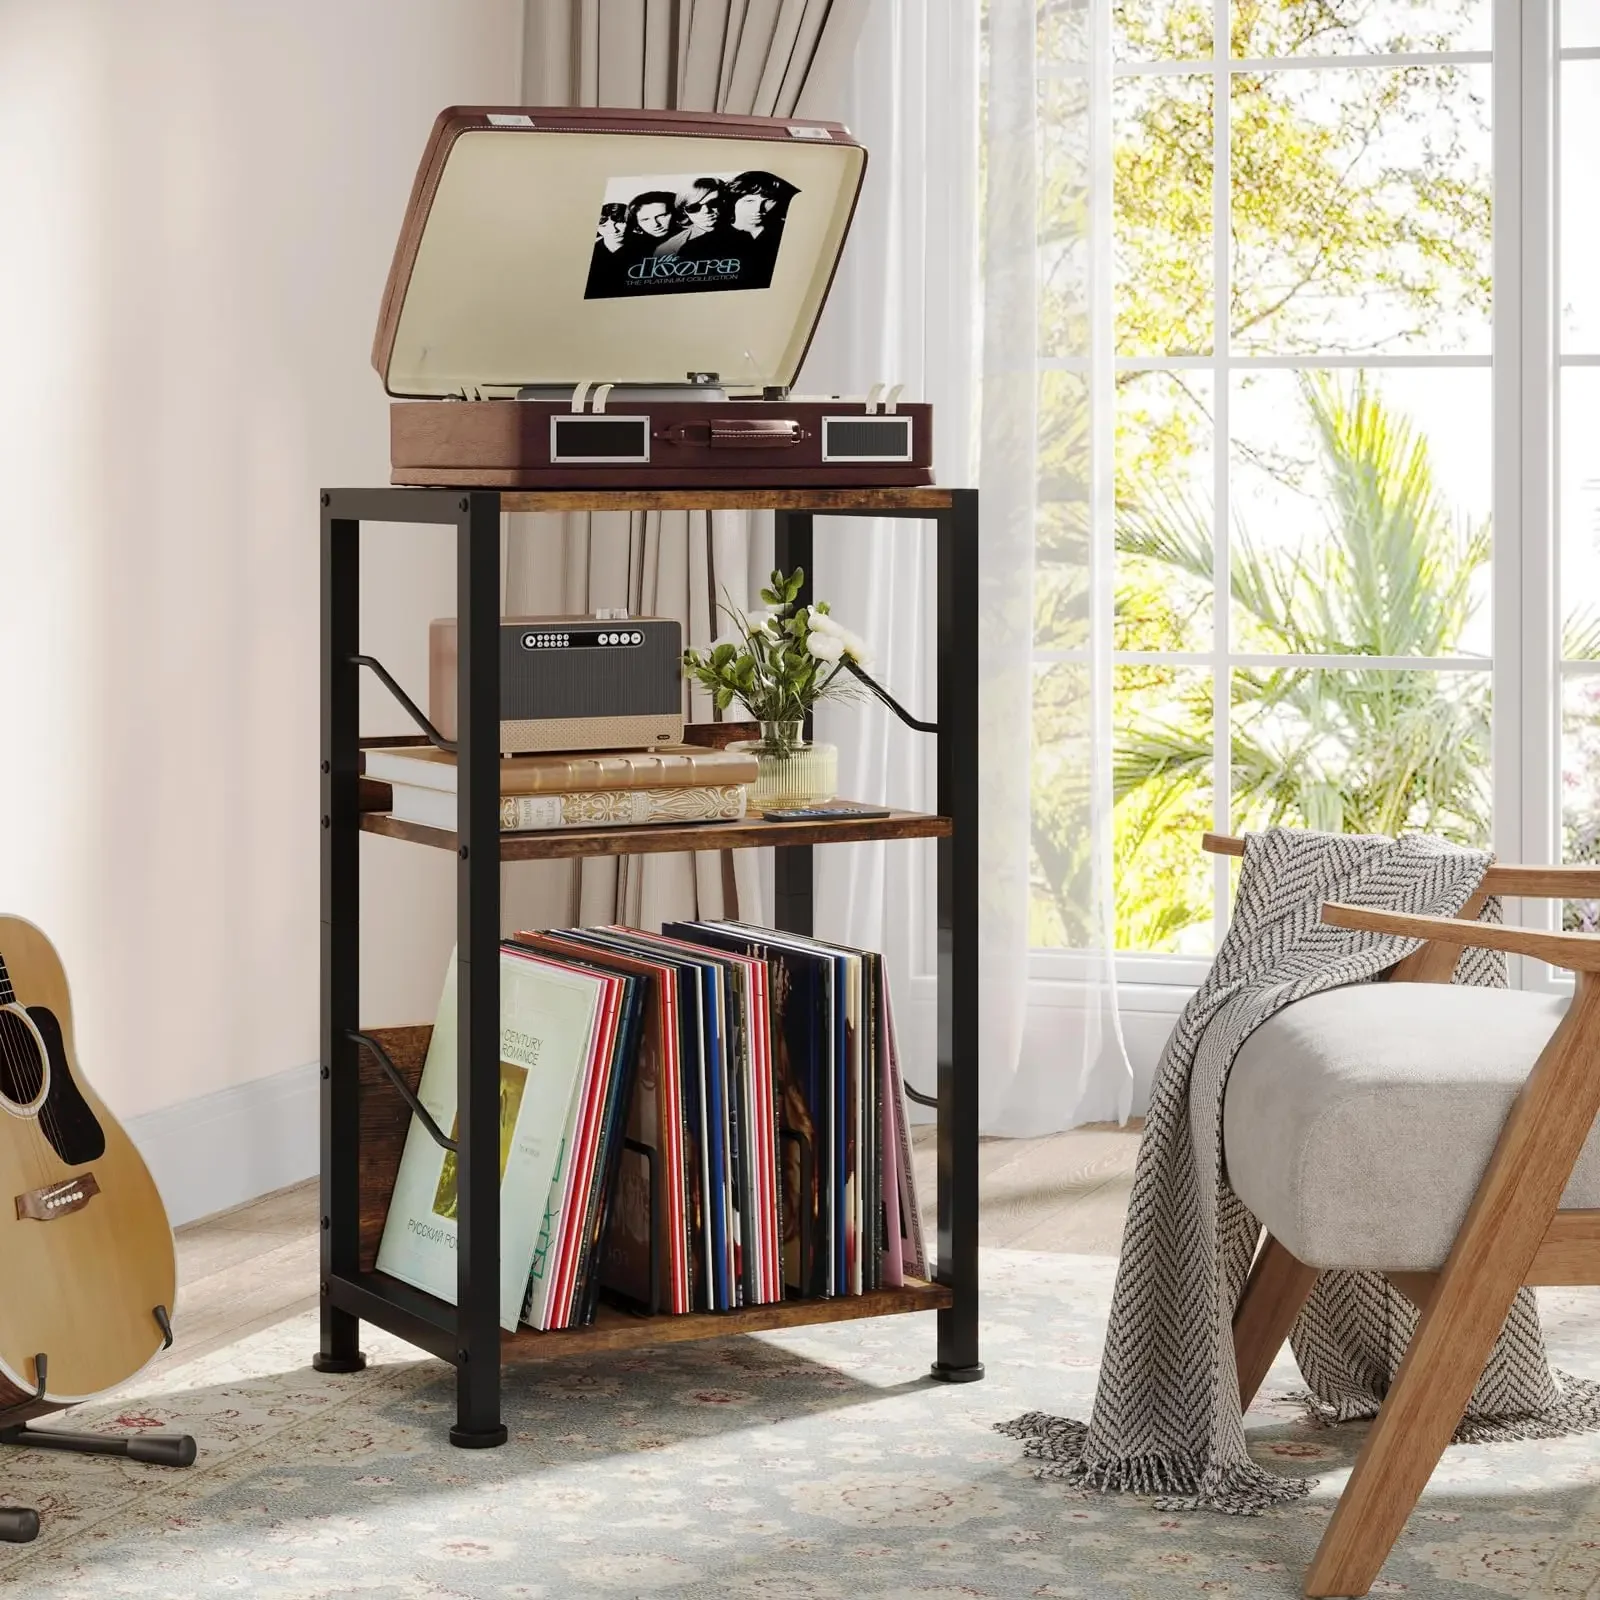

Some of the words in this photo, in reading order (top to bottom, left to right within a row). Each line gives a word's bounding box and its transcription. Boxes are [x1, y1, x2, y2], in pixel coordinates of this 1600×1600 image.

[627, 257, 741, 279] doors
[643, 276, 686, 285] PLATINUM
[686, 274, 739, 282] COLLECTION
[503, 1028, 545, 1052] CENTURY
[501, 1043, 540, 1066] ROMANCE
[407, 1217, 444, 1245] РУССКИЙ
[443, 1232, 458, 1249] РО
